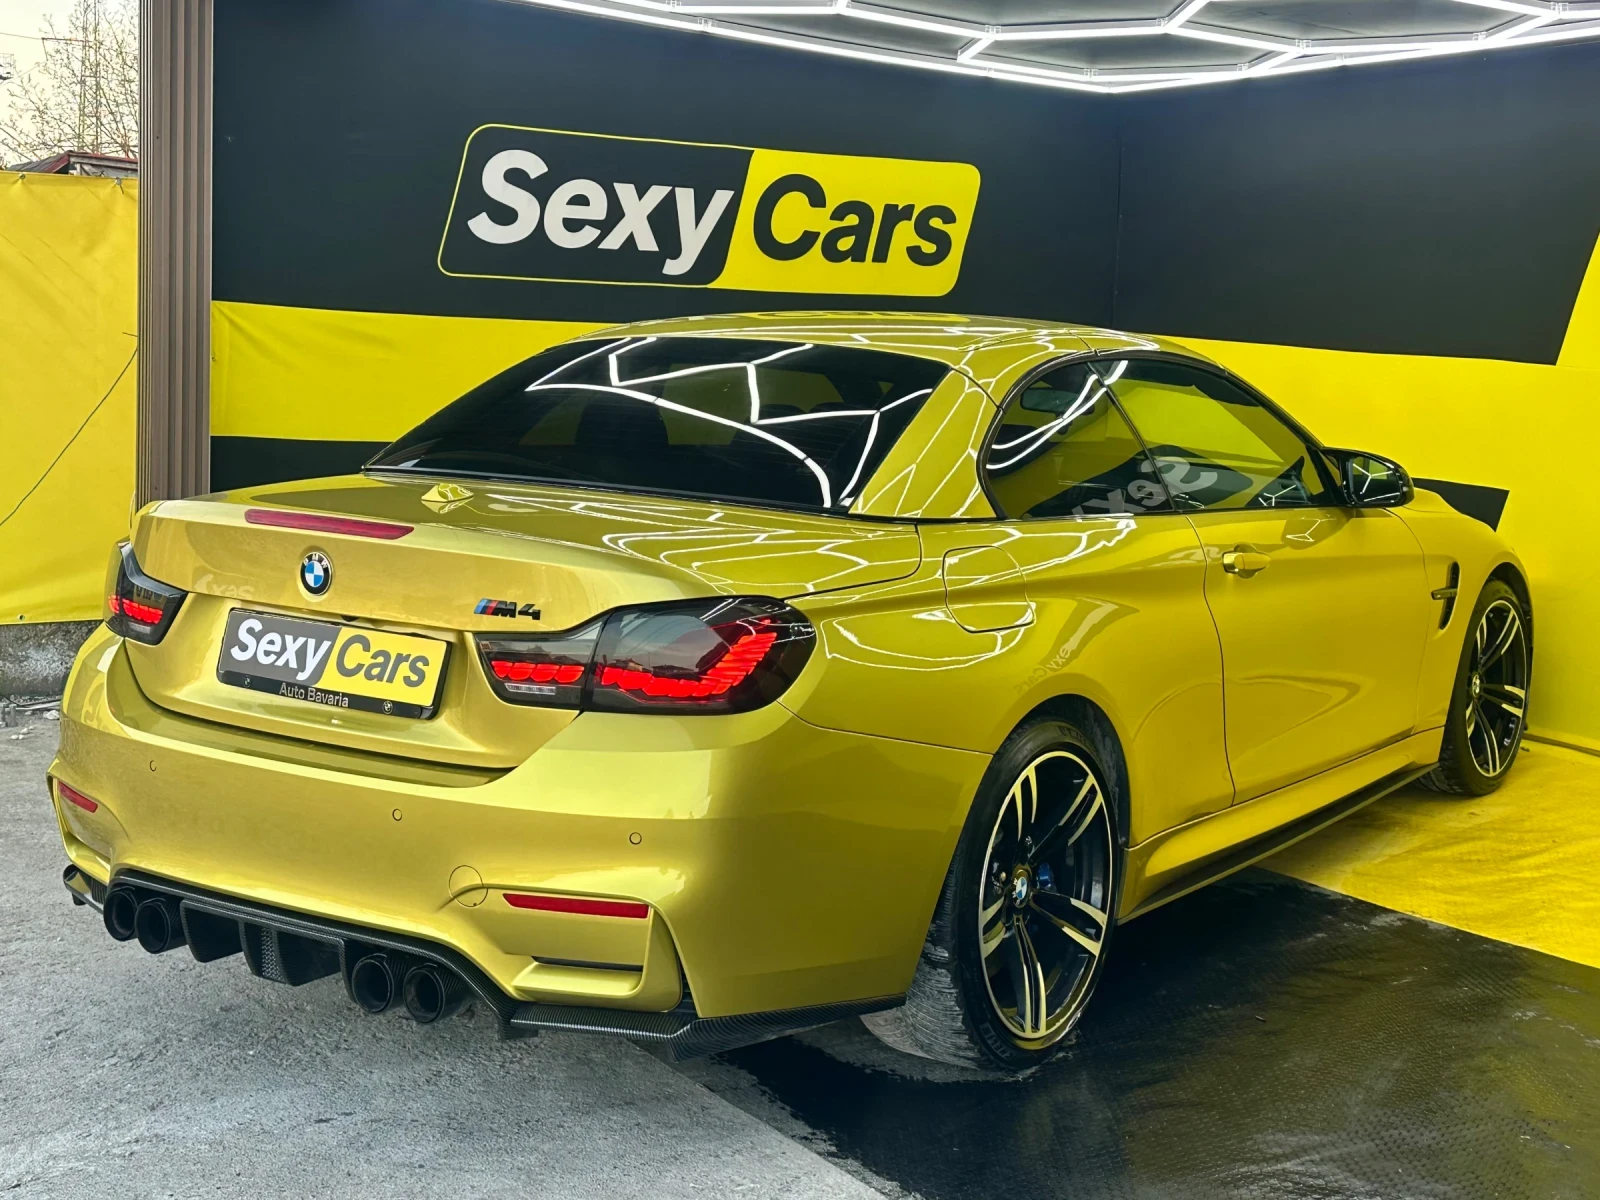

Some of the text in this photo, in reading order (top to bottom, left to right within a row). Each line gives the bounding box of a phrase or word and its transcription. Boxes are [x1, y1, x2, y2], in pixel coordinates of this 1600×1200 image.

[467, 149, 957, 275] Sexy Cars
[490, 599, 541, 621] M4
[230, 618, 430, 687] Sexy Cars
[279, 682, 349, 708] Auto Bavaria
